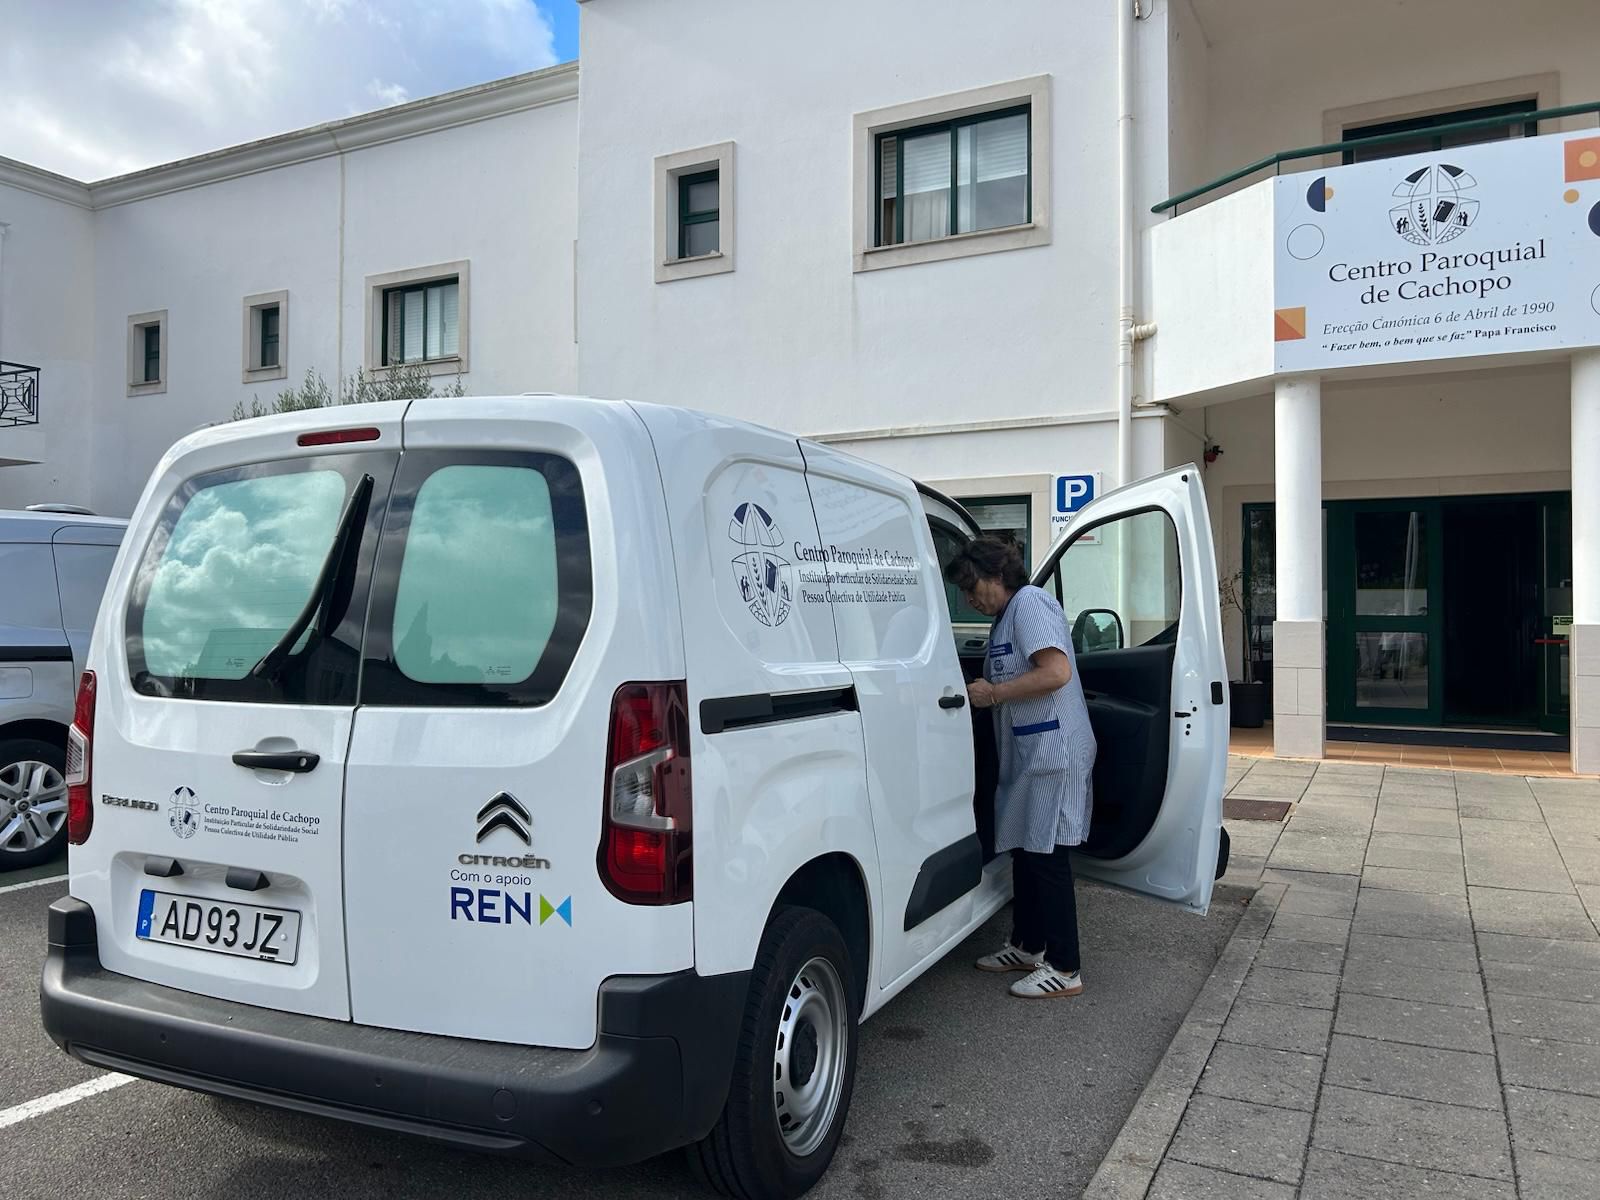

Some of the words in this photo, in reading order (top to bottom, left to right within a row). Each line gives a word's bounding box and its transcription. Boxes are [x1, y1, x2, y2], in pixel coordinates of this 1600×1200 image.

[1328, 258, 1412, 282] Centro
[1420, 238, 1546, 272] Paroquial
[1360, 285, 1390, 304] de
[1398, 275, 1512, 298] Cachopo
[1323, 320, 1369, 335] Erecção
[1372, 314, 1430, 330] Canónica
[1434, 312, 1442, 324] 6
[1446, 311, 1461, 323] de
[1464, 306, 1498, 321] Abril
[1502, 305, 1517, 317] de
[1522, 301, 1555, 315] 1990
[1359, 340, 1381, 349] bem,
[1393, 337, 1413, 346] bem
[1416, 336, 1435, 345] que
[1438, 334, 1447, 342] se
[1474, 329, 1501, 339] Papa
[1504, 324, 1557, 335] Francisco
[1065, 479, 1088, 508] P
[794, 541, 830, 562] Centro
[830, 545, 873, 570] Paroquial
[874, 548, 884, 566] de
[884, 550, 915, 573] Cachopo
[798, 569, 835, 587] Instituição
[836, 572, 864, 585] Particular
[865, 573, 872, 585] de
[872, 573, 905, 585] Solidariedade
[905, 574, 919, 585] Social
[802, 590, 825, 603] Pessoa
[825, 590, 854, 603] Colectiva
[856, 590, 863, 603] de
[863, 590, 888, 603] Utilidade
[102, 794, 159, 811] BERLINGO
[204, 803, 229, 815] Centro
[231, 806, 268, 821] Paroquial
[271, 810, 281, 820] de
[282, 811, 320, 826] Cachopo
[204, 816, 230, 825] Instituição
[230, 819, 254, 829] Particular
[263, 823, 300, 833] Solidariedade
[301, 826, 319, 835] Social
[204, 825, 220, 834] Pessoa
[220, 827, 243, 836] Colectiva
[251, 830, 276, 840] Utilidade
[278, 833, 298, 843] Pública
[458, 853, 551, 869] CITROËN
[450, 869, 480, 882] Com
[484, 873, 492, 883] o
[496, 874, 532, 887] apoio
[451, 886, 531, 926] REN
[141, 920, 148, 930] P
